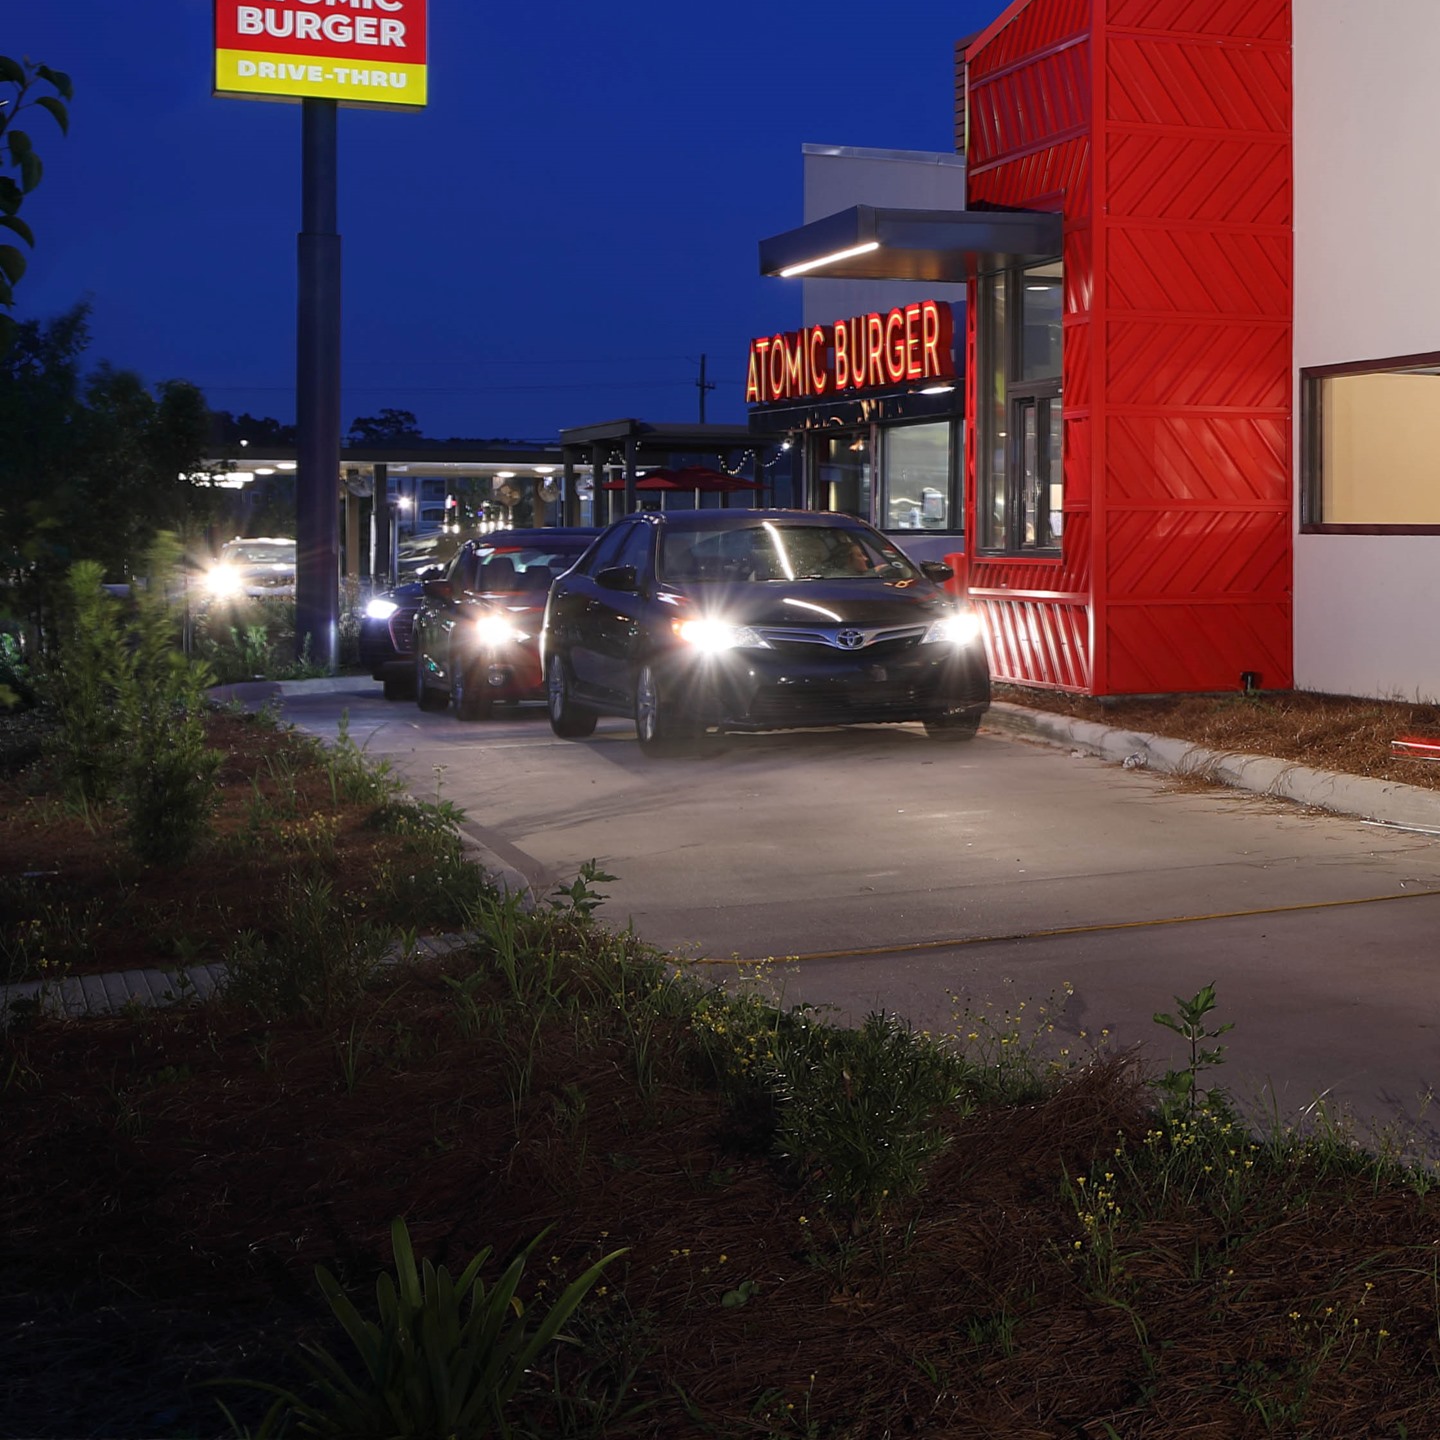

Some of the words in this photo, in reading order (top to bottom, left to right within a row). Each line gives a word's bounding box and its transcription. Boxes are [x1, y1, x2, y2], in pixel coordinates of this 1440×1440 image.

[236, 5, 407, 48] BURGER
[237, 59, 408, 89] DRIVE-THRU
[746, 324, 828, 404] ATOMIC
[834, 299, 943, 391] BURGER
